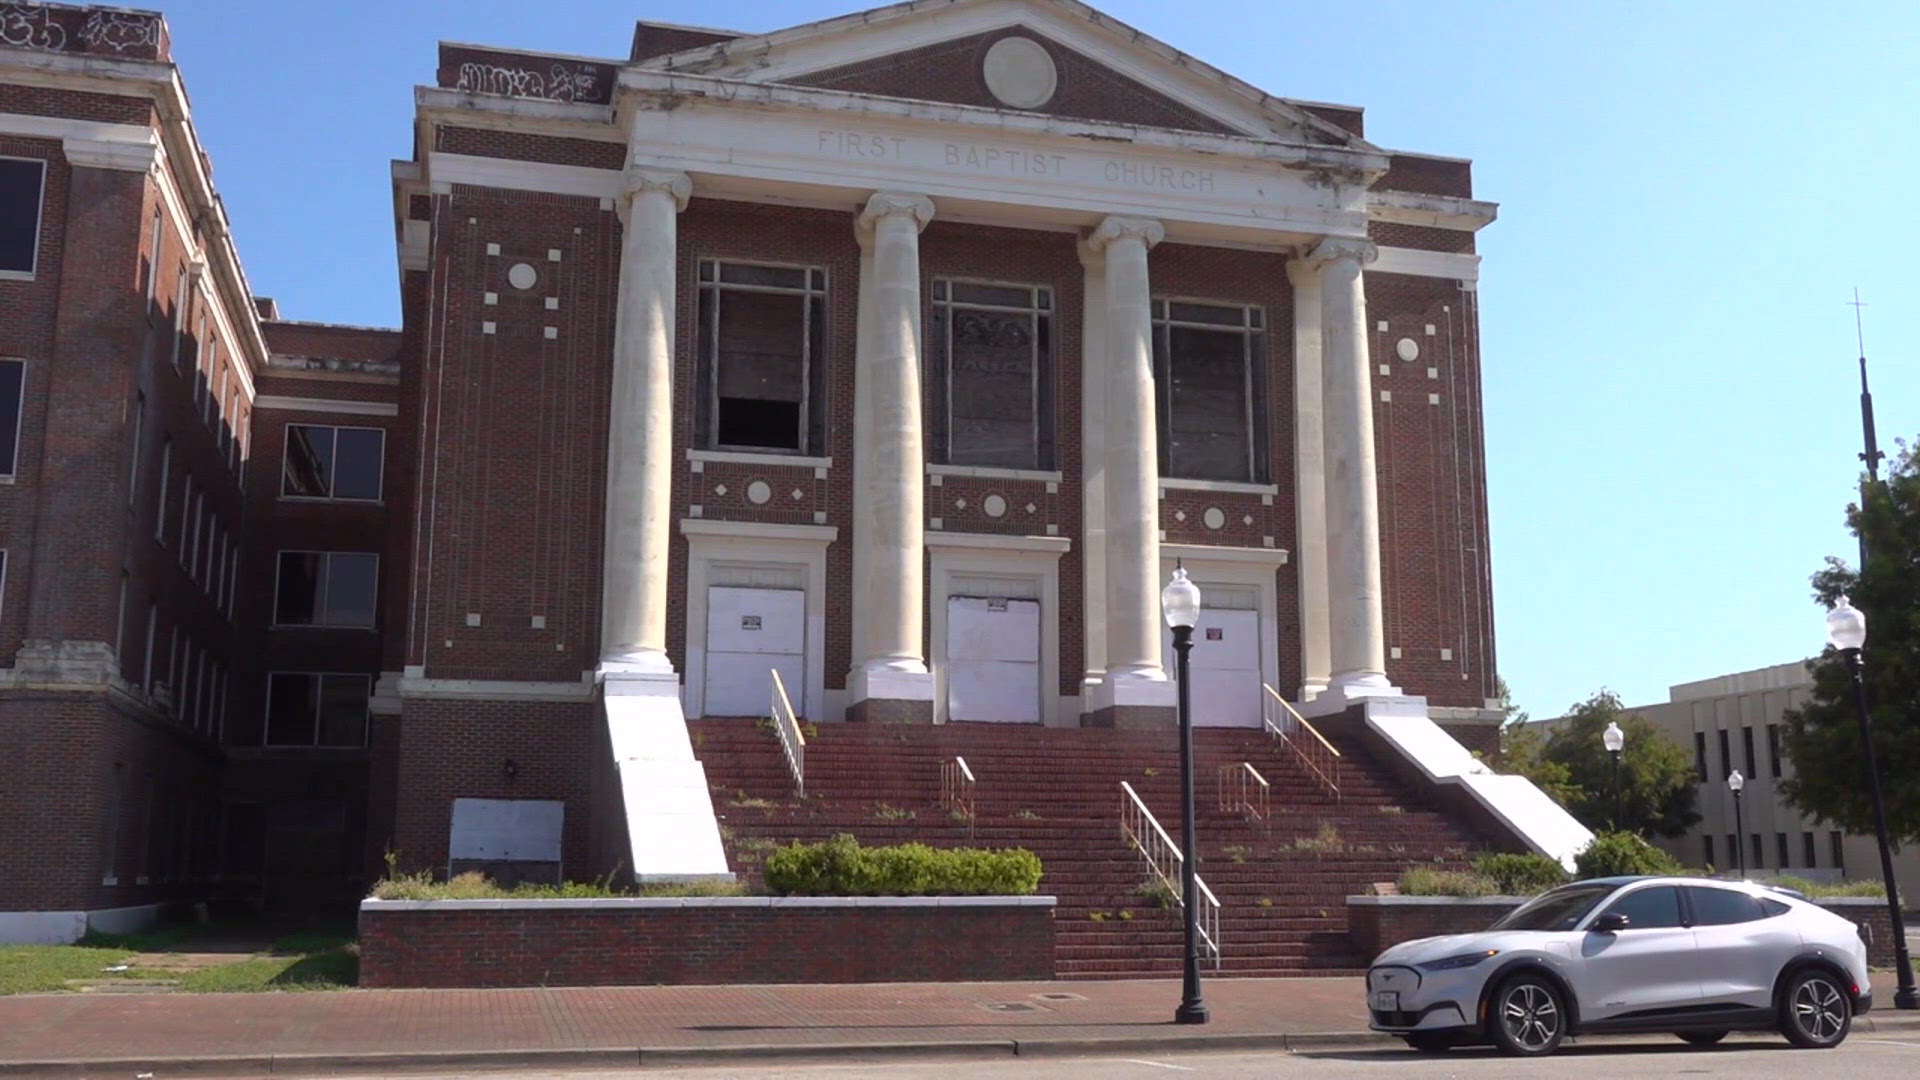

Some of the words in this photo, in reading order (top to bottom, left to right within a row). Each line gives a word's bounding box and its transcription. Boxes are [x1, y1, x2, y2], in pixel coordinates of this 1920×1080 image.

[818, 130, 906, 159] FIRST
[945, 143, 1066, 176] BAPTIST
[1104, 161, 1215, 192] CHURCH
